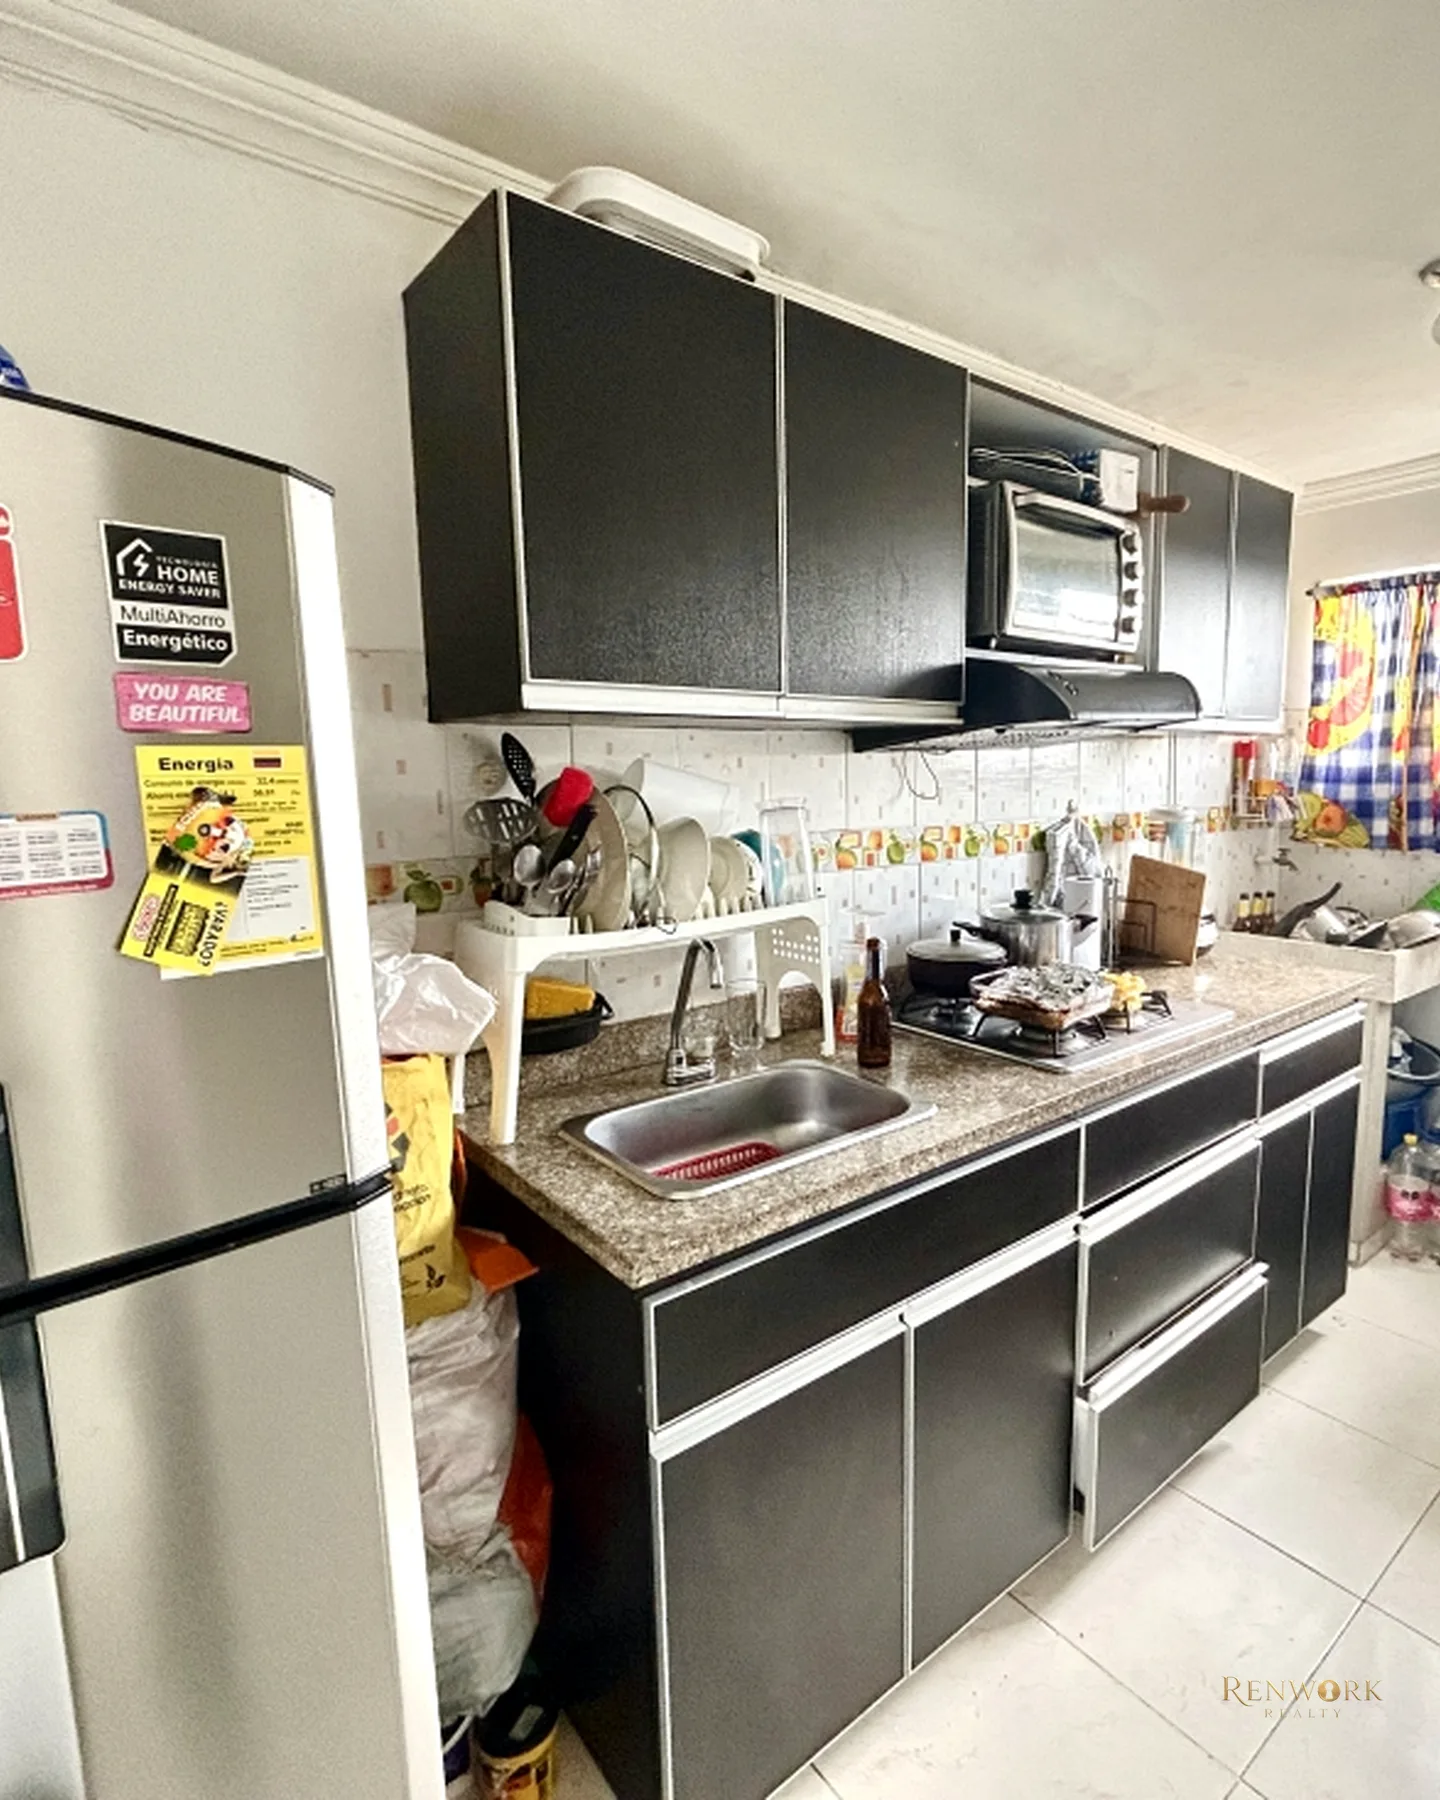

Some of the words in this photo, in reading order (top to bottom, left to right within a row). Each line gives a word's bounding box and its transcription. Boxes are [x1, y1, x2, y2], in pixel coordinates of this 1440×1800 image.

[157, 565, 219, 586] HOME
[118, 579, 175, 594] ENERGY
[177, 585, 221, 599] SAVER
[120, 605, 226, 628] MultiAhorro
[123, 628, 229, 653] Energético
[133, 681, 179, 701] YOU
[184, 684, 228, 703] ARE
[129, 703, 242, 723] BEAUTIFUL
